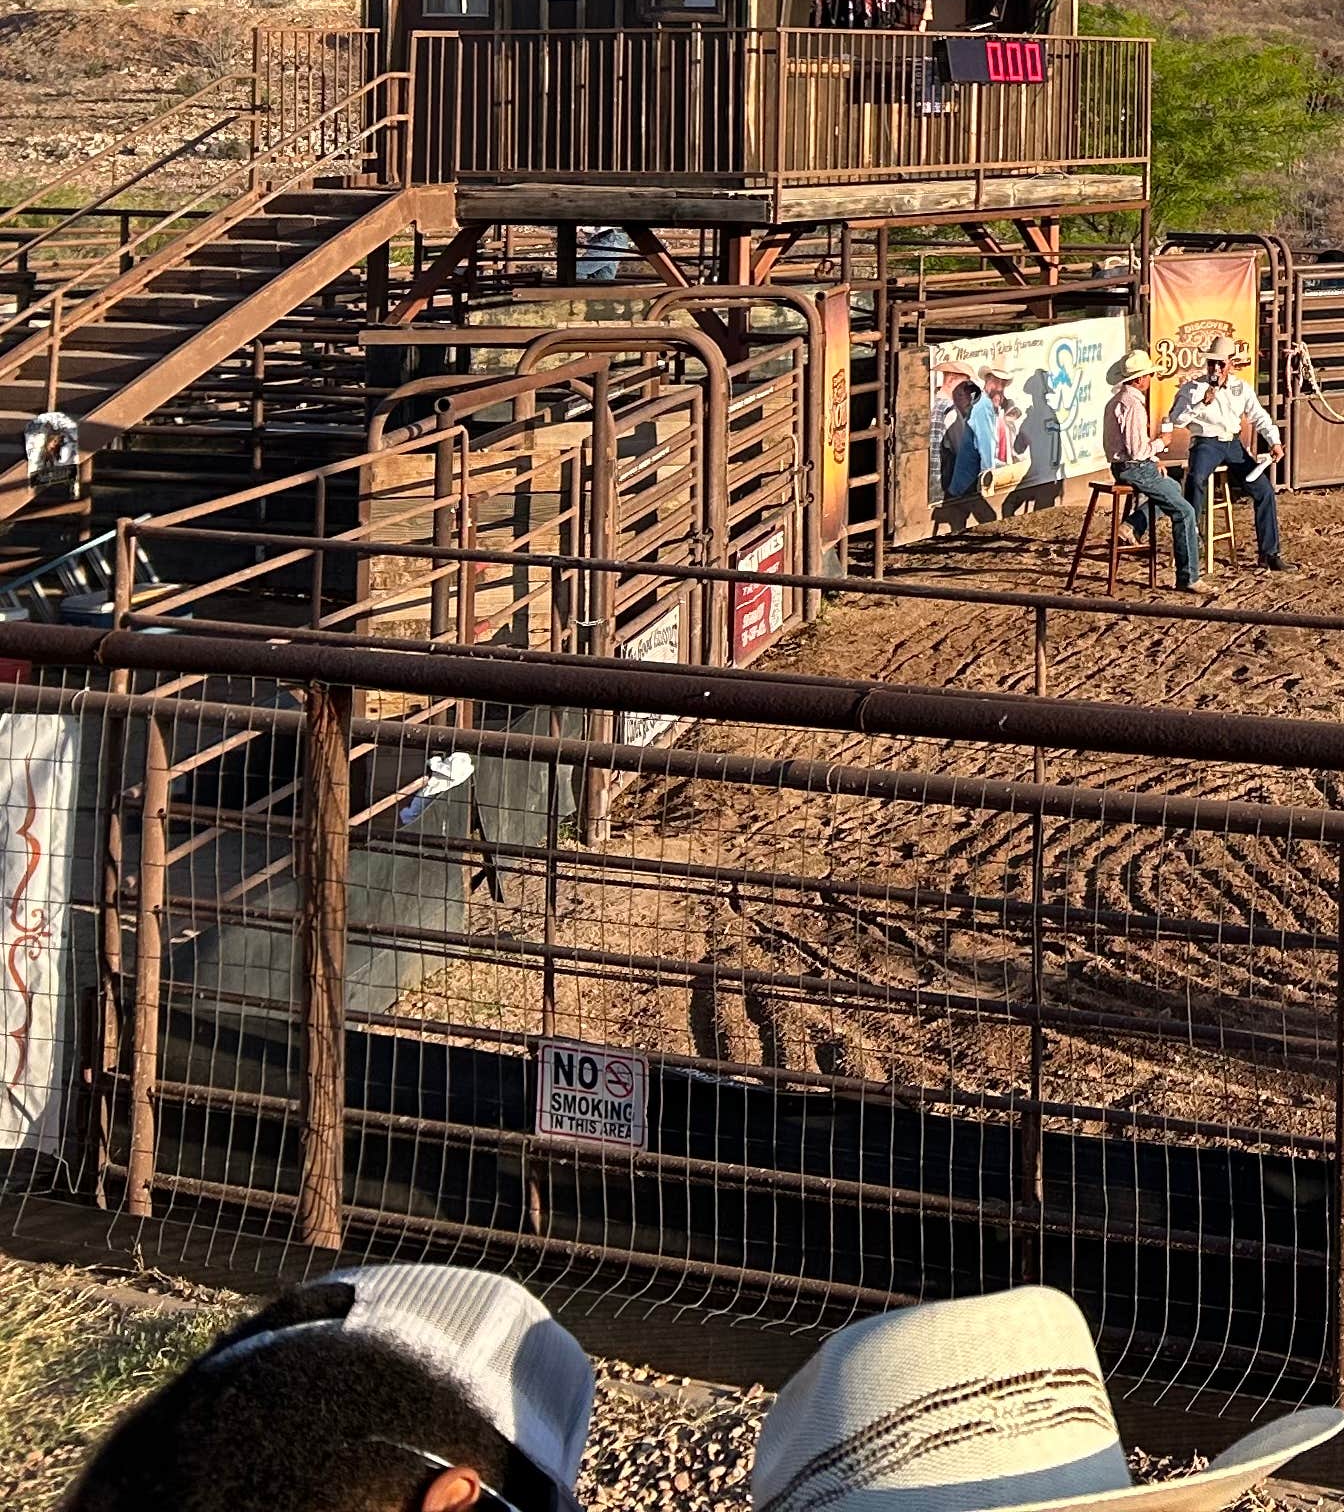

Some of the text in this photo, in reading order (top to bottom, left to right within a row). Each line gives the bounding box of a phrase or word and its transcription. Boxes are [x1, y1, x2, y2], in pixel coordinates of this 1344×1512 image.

[554, 1052, 598, 1090] NO
[552, 1092, 635, 1123] SMOKING
[551, 1114, 632, 1139] IN THIS AREA
